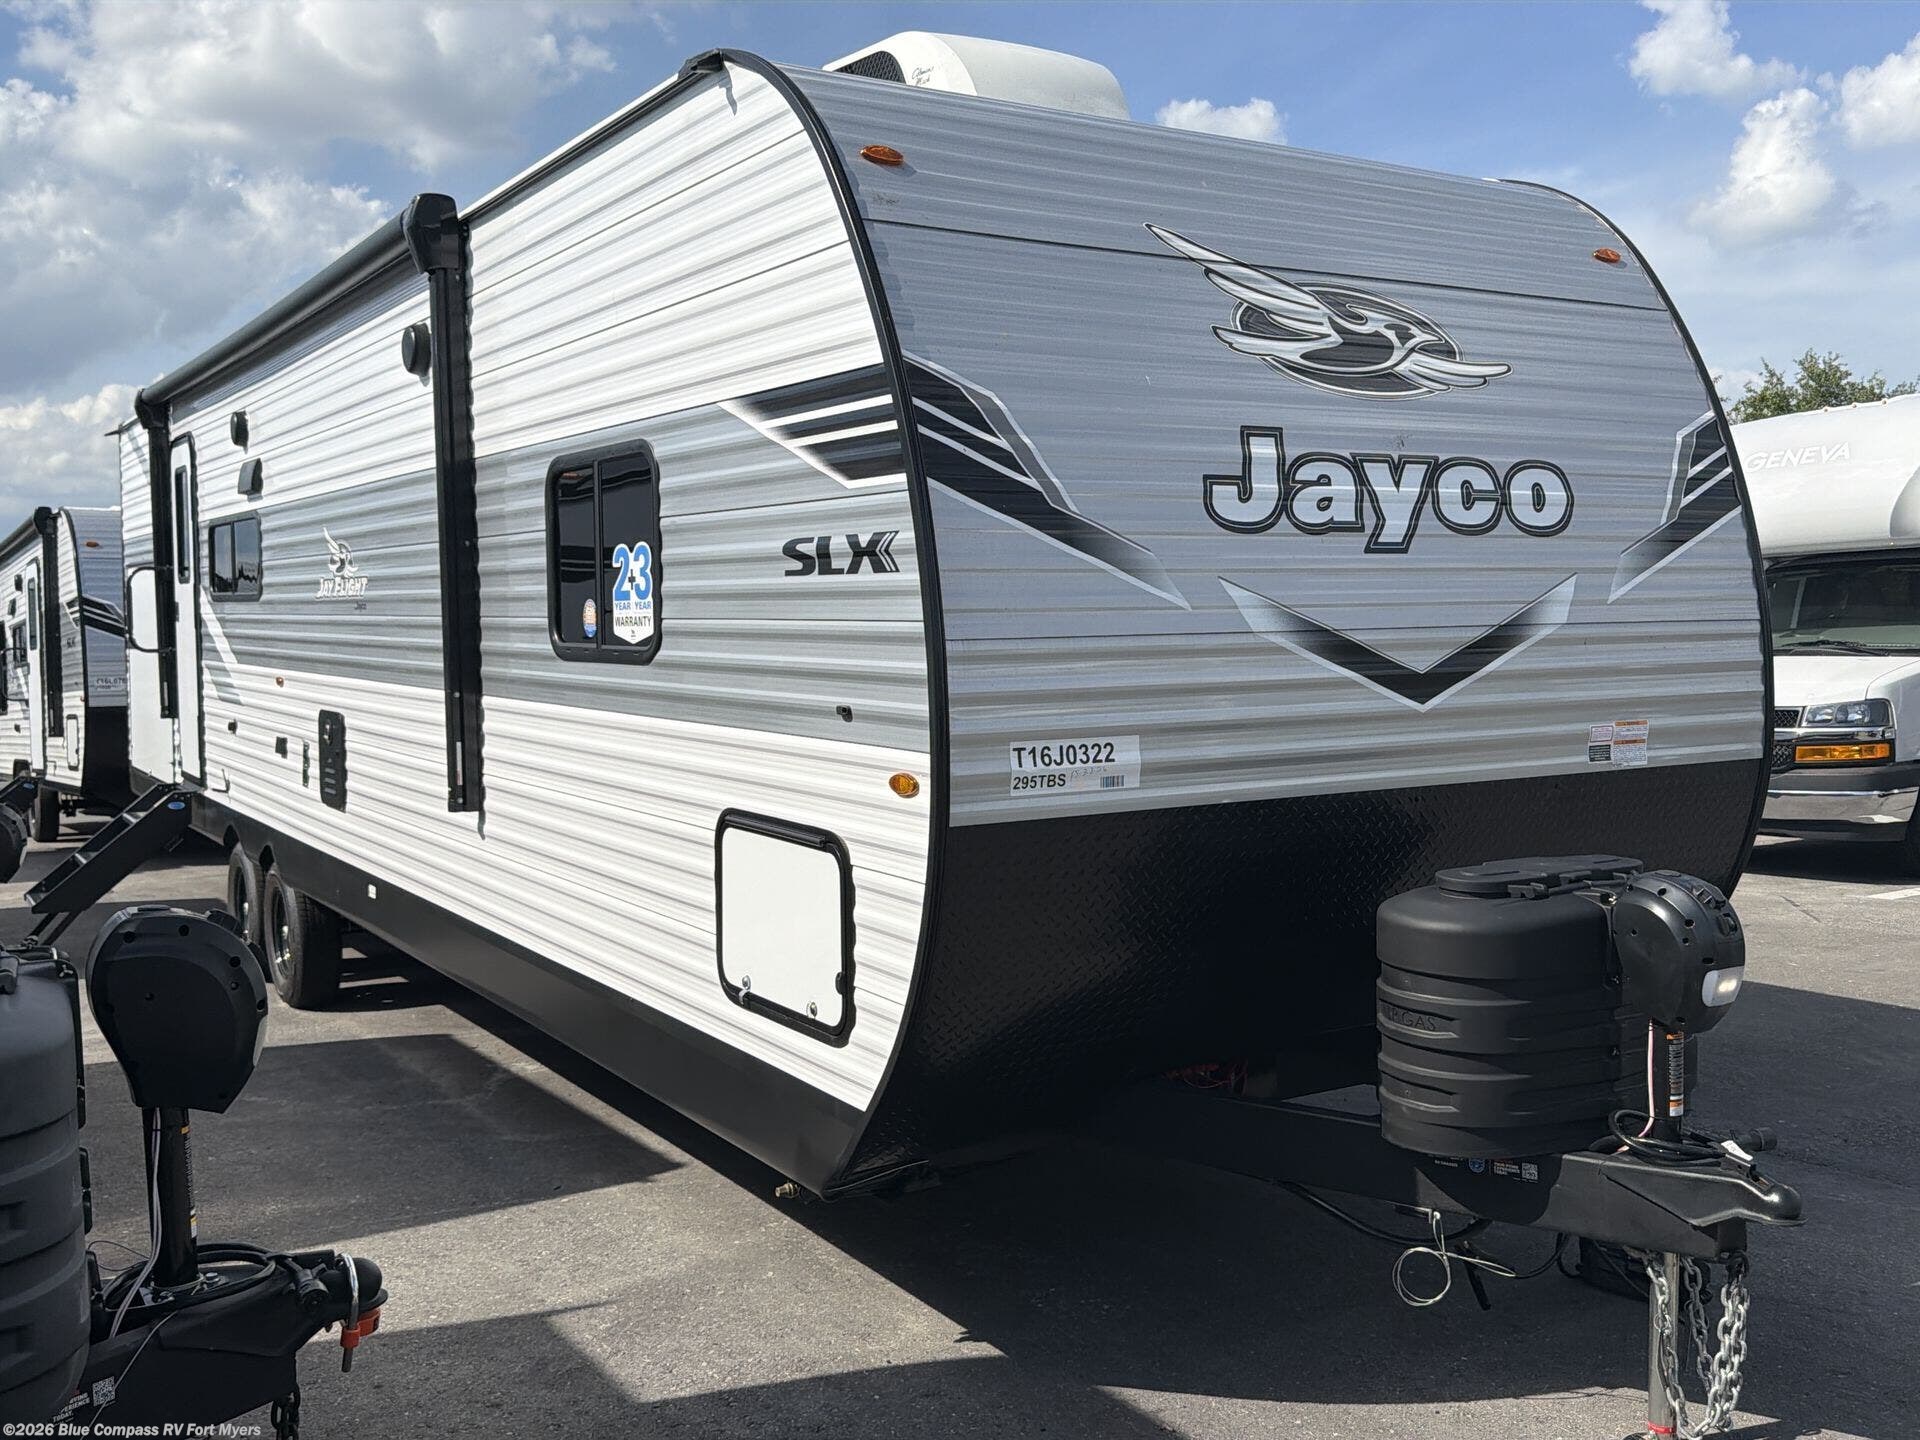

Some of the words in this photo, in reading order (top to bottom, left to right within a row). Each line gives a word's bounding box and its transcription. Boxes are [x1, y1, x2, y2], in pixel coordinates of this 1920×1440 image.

[1746, 442, 1850, 472] GENEVA
[1203, 425, 1575, 554] Jayco
[782, 530, 900, 576] SLX
[334, 576, 368, 597] FLIGHT
[614, 602, 632, 611] YEAR
[634, 601, 651, 611] YEAR
[615, 616, 651, 627] WARRANTY
[1012, 742, 1116, 768] T16J0322
[1012, 774, 1067, 790] 295TBS
[1402, 1010, 1436, 1031] GAS
